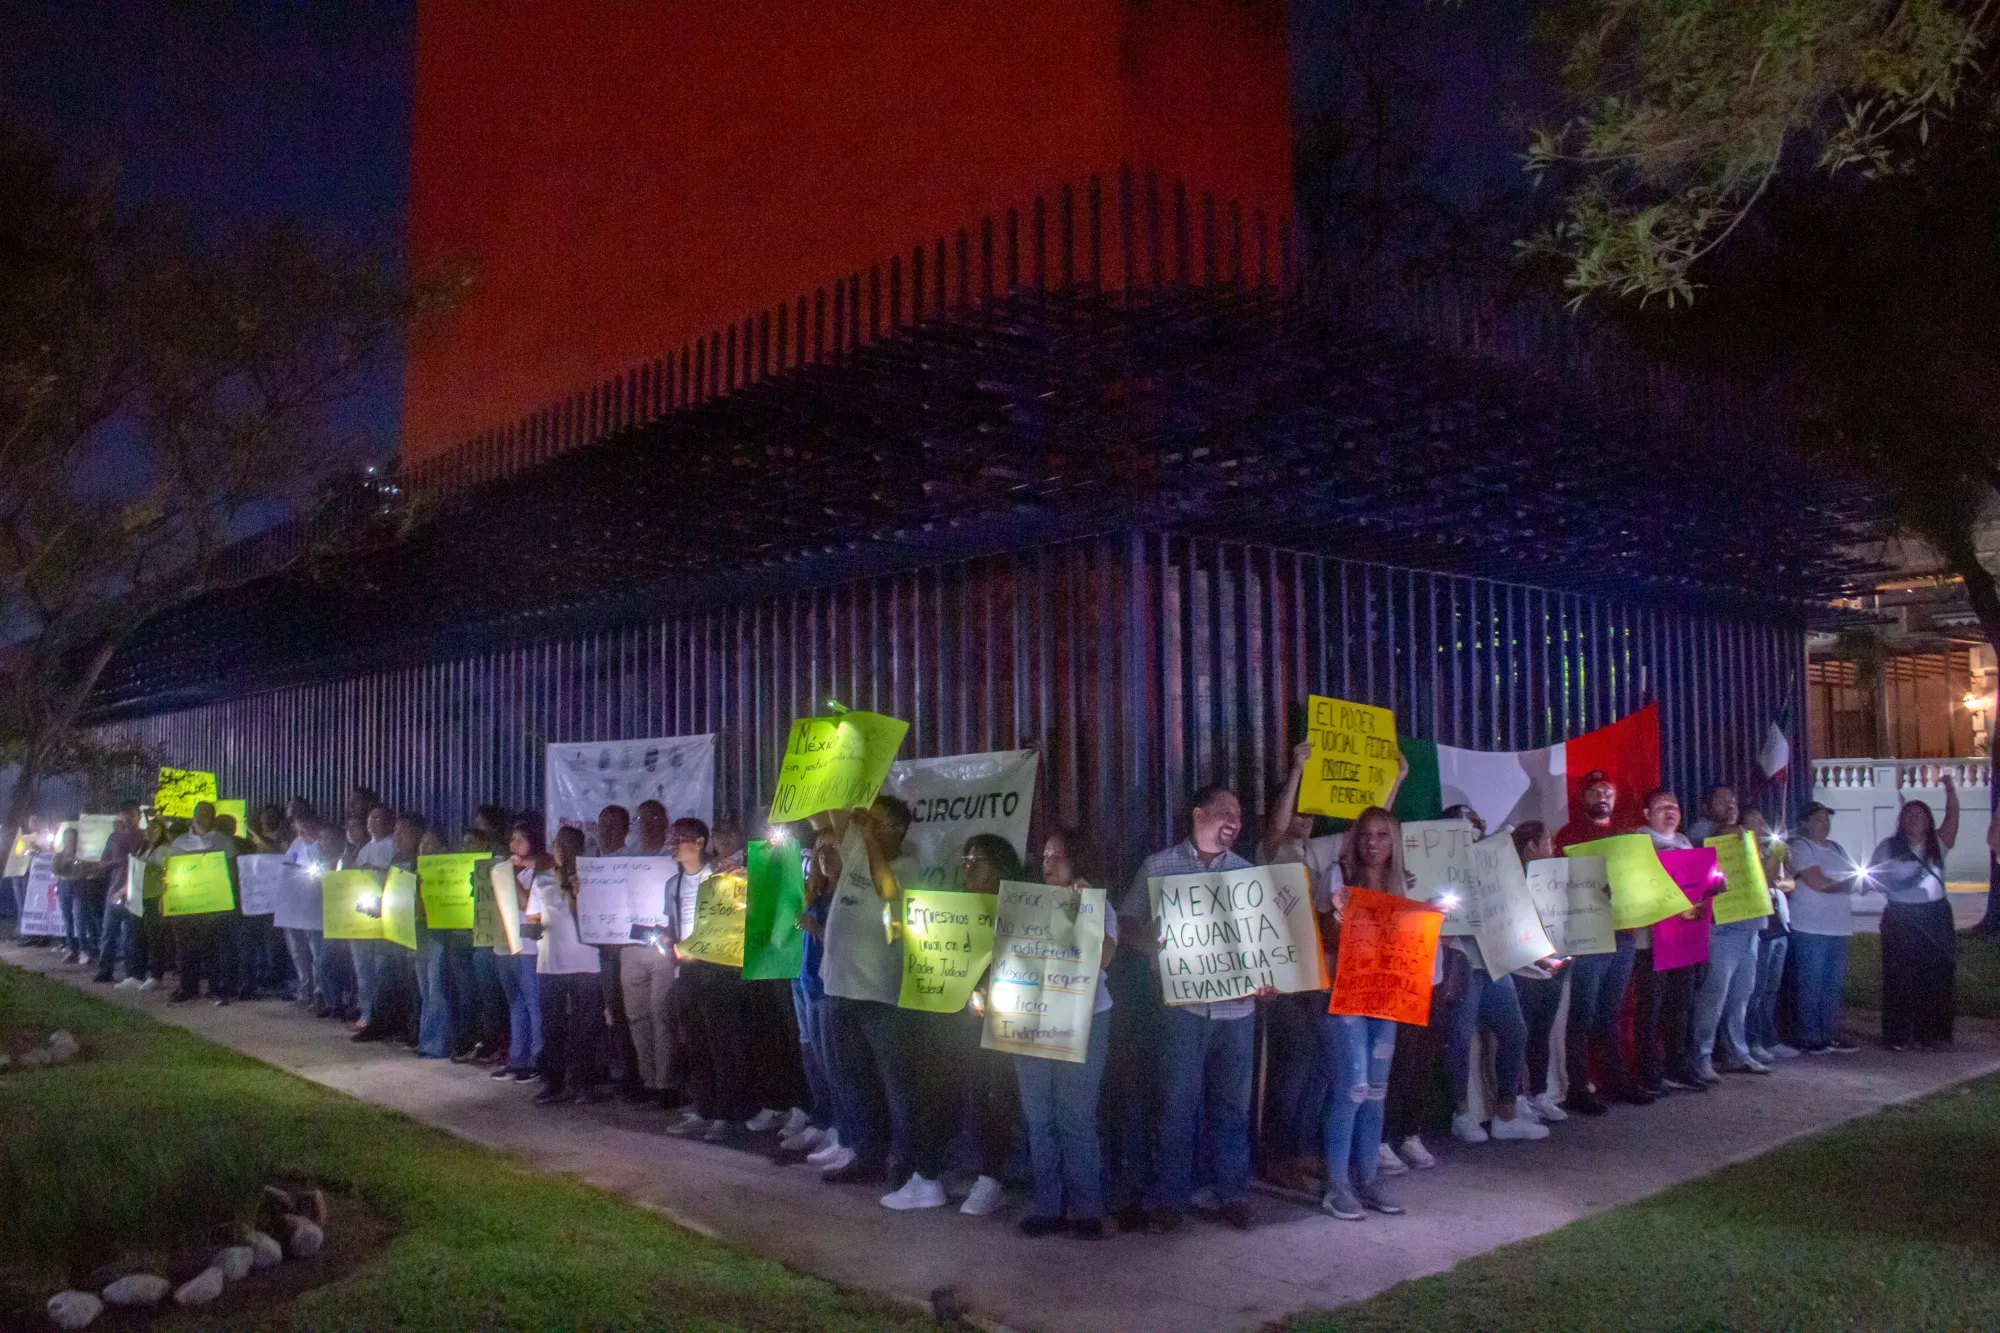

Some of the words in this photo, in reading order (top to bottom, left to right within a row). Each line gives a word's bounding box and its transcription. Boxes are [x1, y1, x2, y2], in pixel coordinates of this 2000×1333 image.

[1316, 701, 1336, 728] EL
[1340, 706, 1375, 734] PODER
[771, 783, 797, 817] NO
[912, 791, 1019, 823] CIRCUITO
[1160, 880, 1264, 919] MEXICO
[978, 913, 993, 928] en
[1163, 913, 1279, 951] AGUANTA
[1166, 957, 1192, 977] LA
[1194, 948, 1271, 976] JUSTICIA
[1271, 944, 1299, 965] SE
